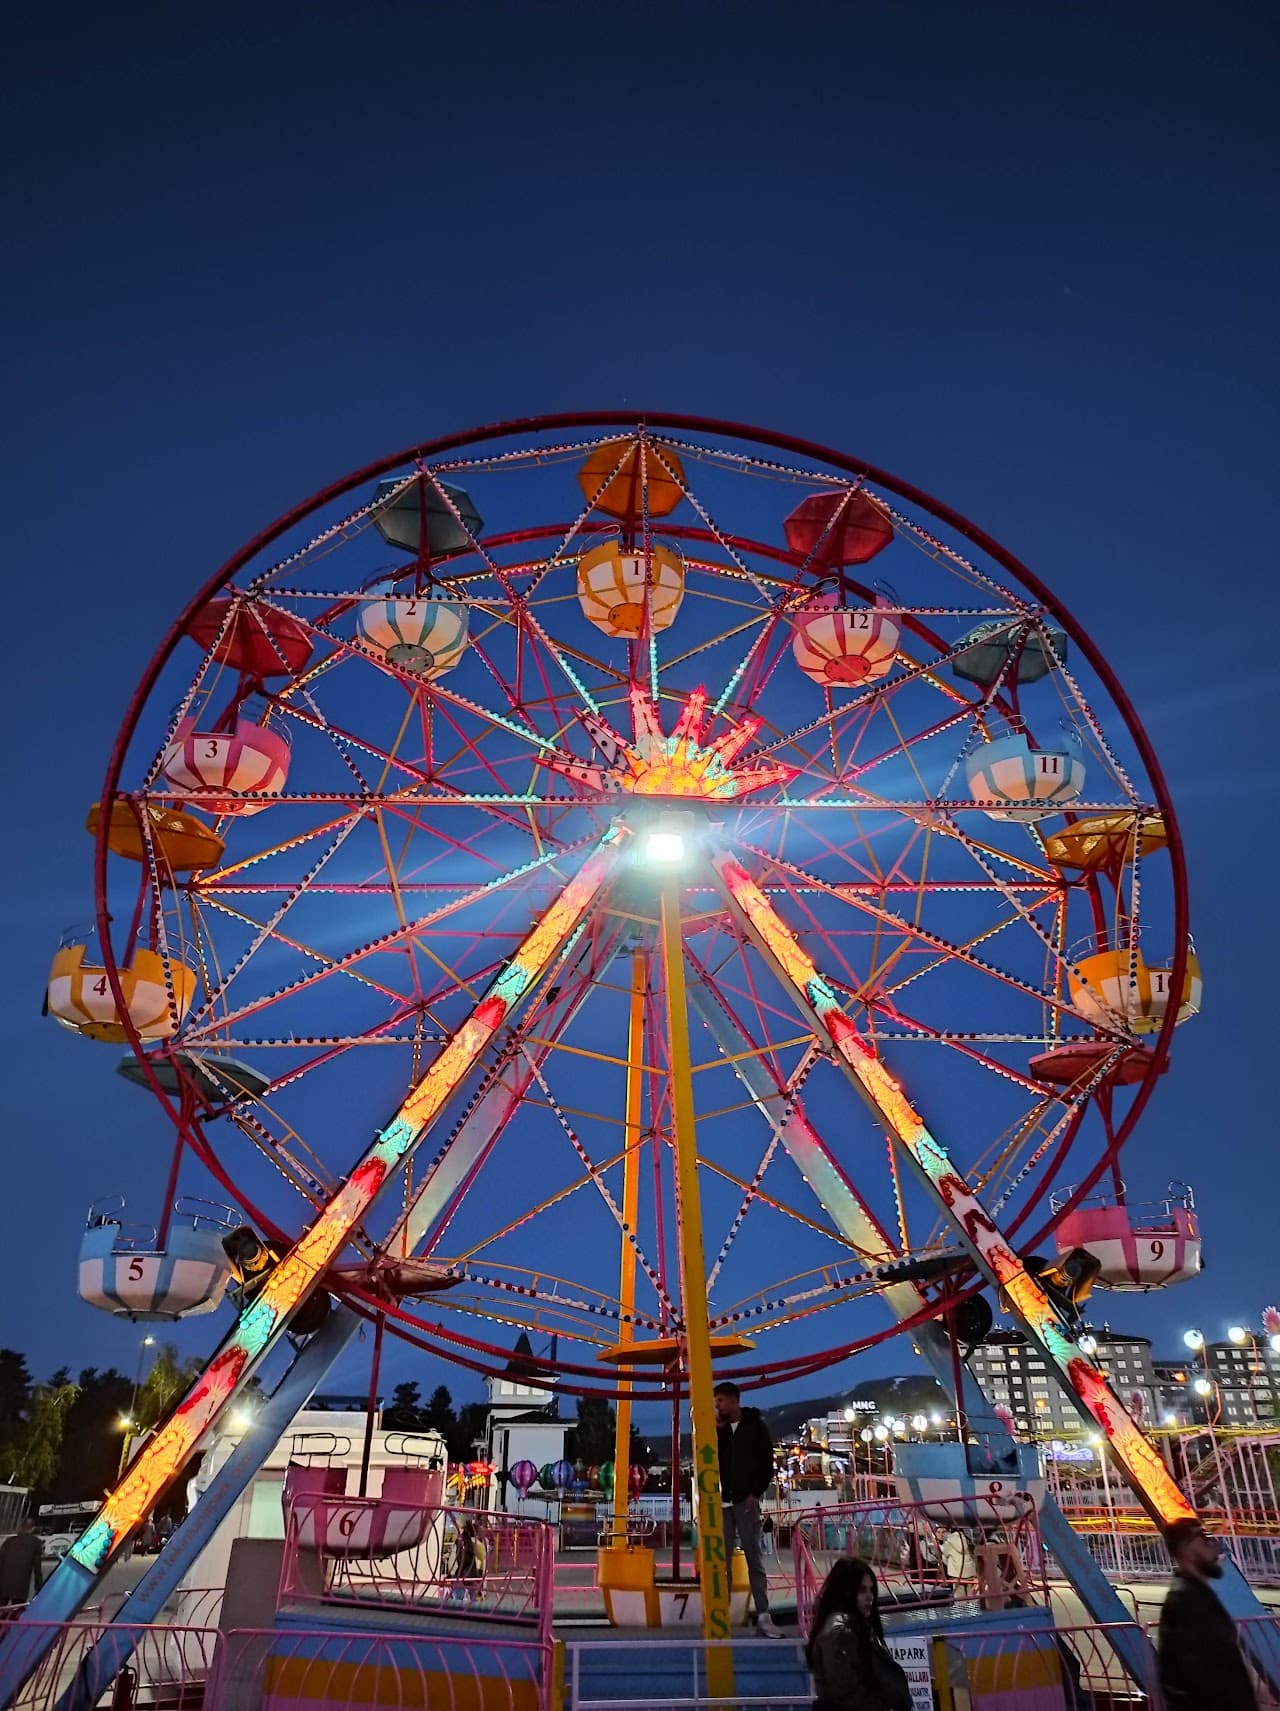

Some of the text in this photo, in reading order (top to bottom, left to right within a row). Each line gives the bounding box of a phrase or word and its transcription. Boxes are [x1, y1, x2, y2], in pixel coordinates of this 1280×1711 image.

[632, 559, 641, 576] 1
[406, 600, 417, 616] 2
[848, 612, 869, 629] 12
[204, 740, 218, 758] 3
[1040, 756, 1061, 774] 11
[92, 975, 107, 996] 4
[1155, 973, 1171, 993] 1
[1150, 1240, 1164, 1262] 9
[128, 1257, 145, 1281] 5
[852, 1400, 876, 1410] MNG
[339, 1510, 357, 1537] 6
[673, 1593, 689, 1620] 7
